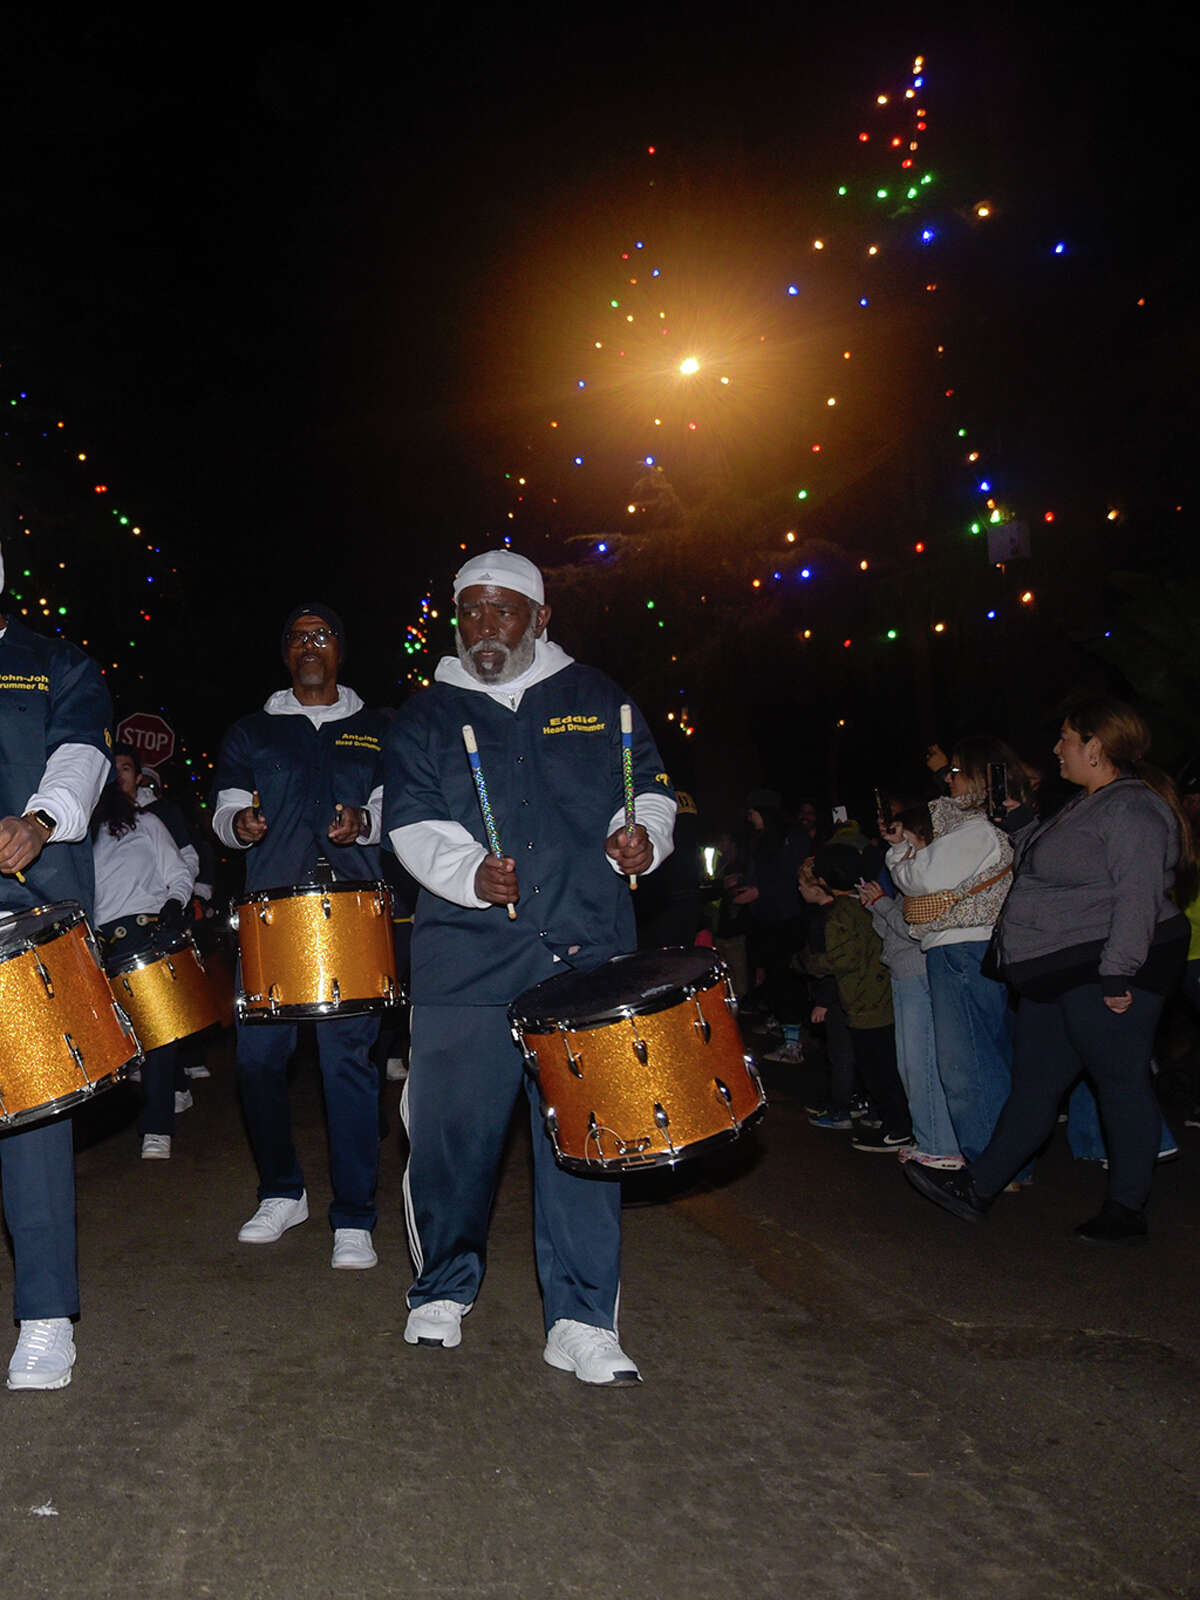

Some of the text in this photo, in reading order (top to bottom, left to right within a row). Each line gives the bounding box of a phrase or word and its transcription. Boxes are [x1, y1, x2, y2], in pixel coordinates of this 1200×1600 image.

[549, 715, 599, 727] Eddie
[542, 722, 607, 735] Head Drummer
[122, 727, 169, 752] STOP
